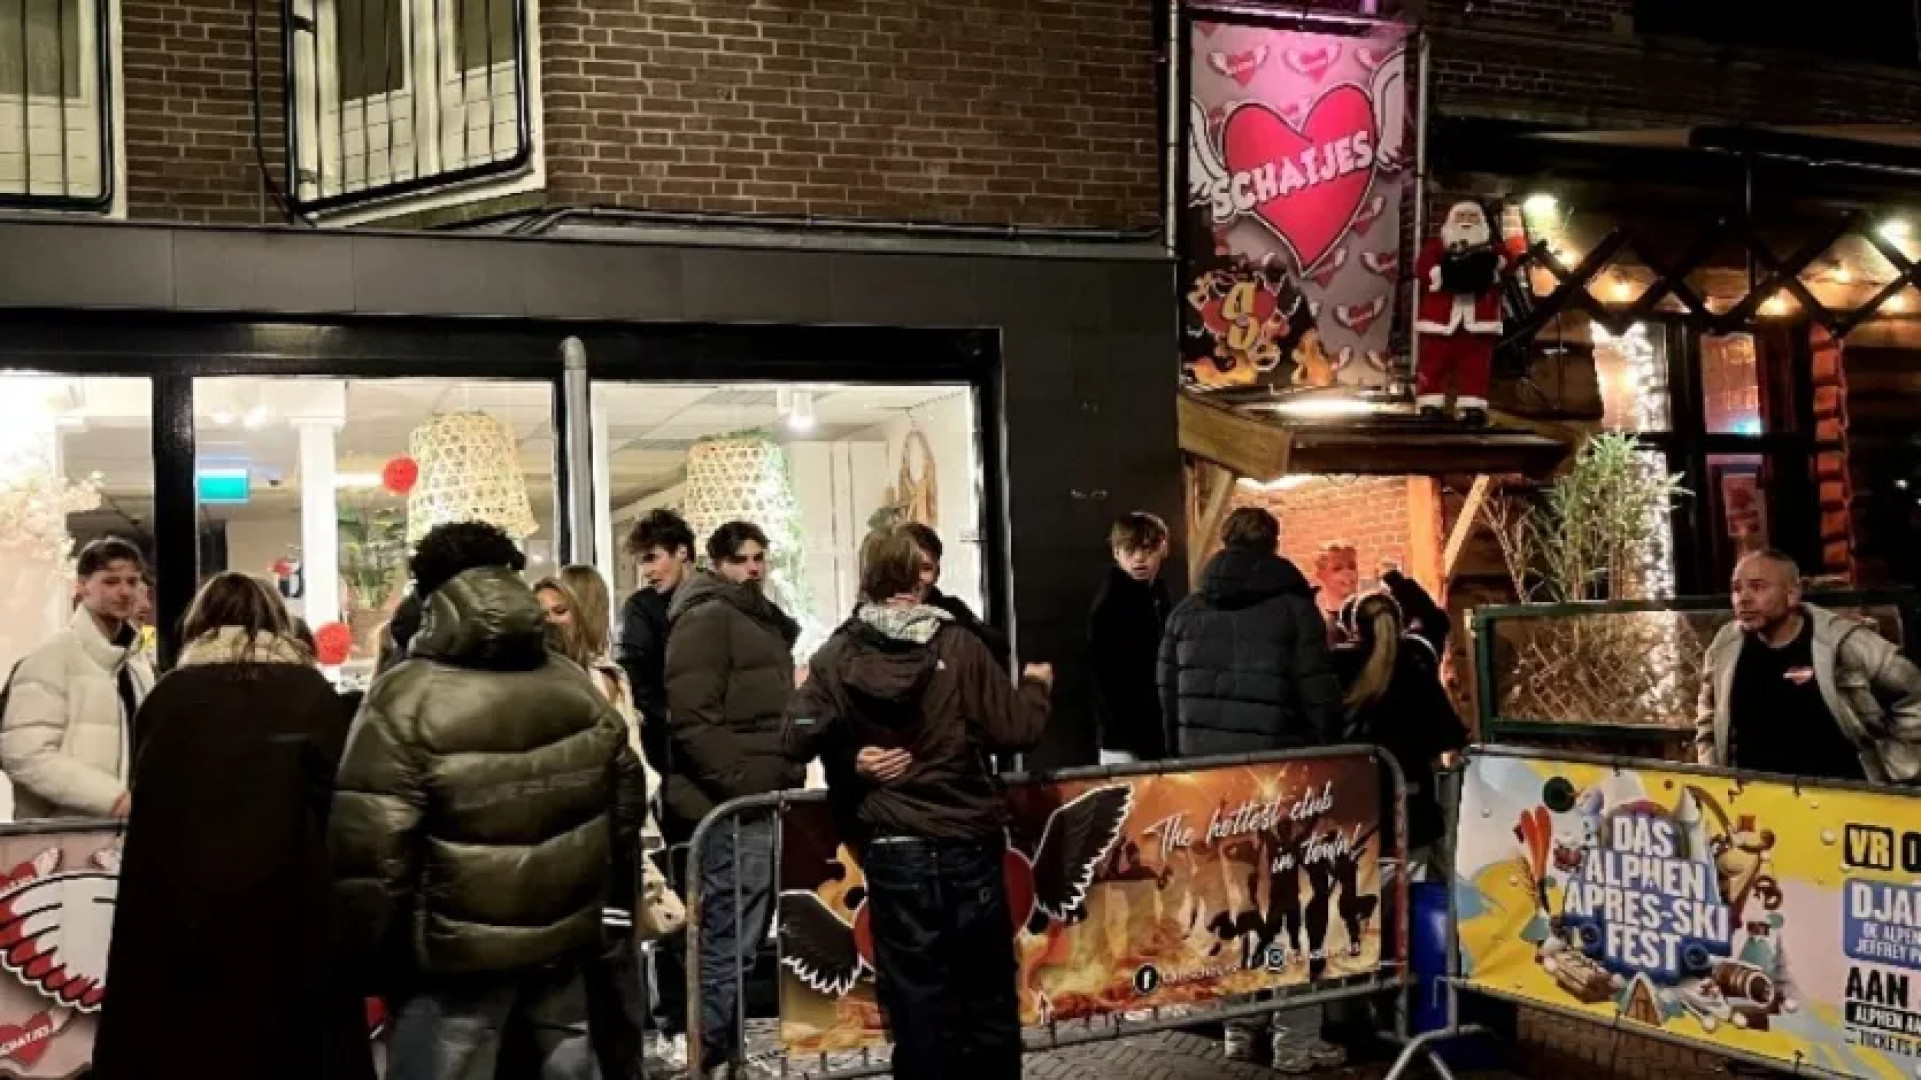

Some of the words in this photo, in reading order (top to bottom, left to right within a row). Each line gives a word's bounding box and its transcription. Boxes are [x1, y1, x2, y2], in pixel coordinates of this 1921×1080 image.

[1212, 130, 1374, 220] SCHATJES
[1142, 810, 1191, 856] The
[1205, 797, 1284, 843] hottest
[1290, 780, 1334, 822] club
[1613, 816, 1674, 856] DAS
[1272, 846, 1294, 874] in
[1850, 829, 1891, 867] VR
[1587, 849, 1704, 899] ALPHEN
[1565, 880, 1729, 942] APRES-SKI
[1606, 924, 1679, 971] FEST
[1845, 966, 1908, 1008] AAN
